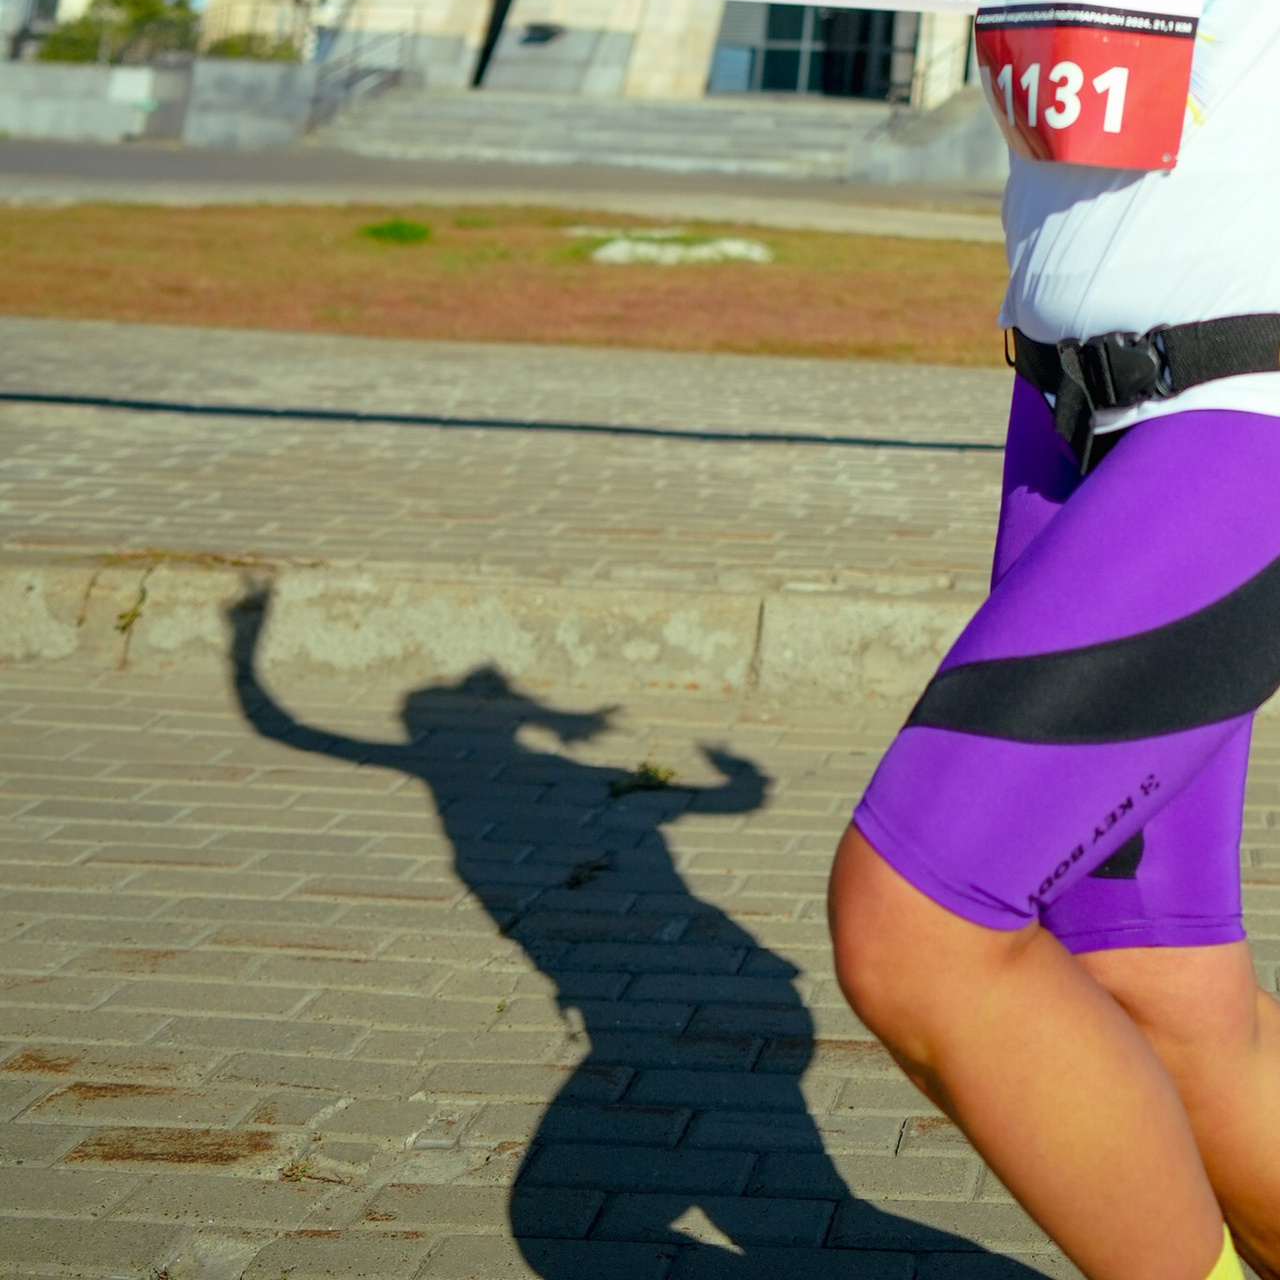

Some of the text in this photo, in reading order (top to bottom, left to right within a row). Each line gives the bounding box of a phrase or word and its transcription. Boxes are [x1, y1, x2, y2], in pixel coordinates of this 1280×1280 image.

[1055, 9, 1125, 27] ПОЛУМАРАФОН
[1153, 18, 1175, 32] 21,1
[1093, 796, 1134, 845] KEY
